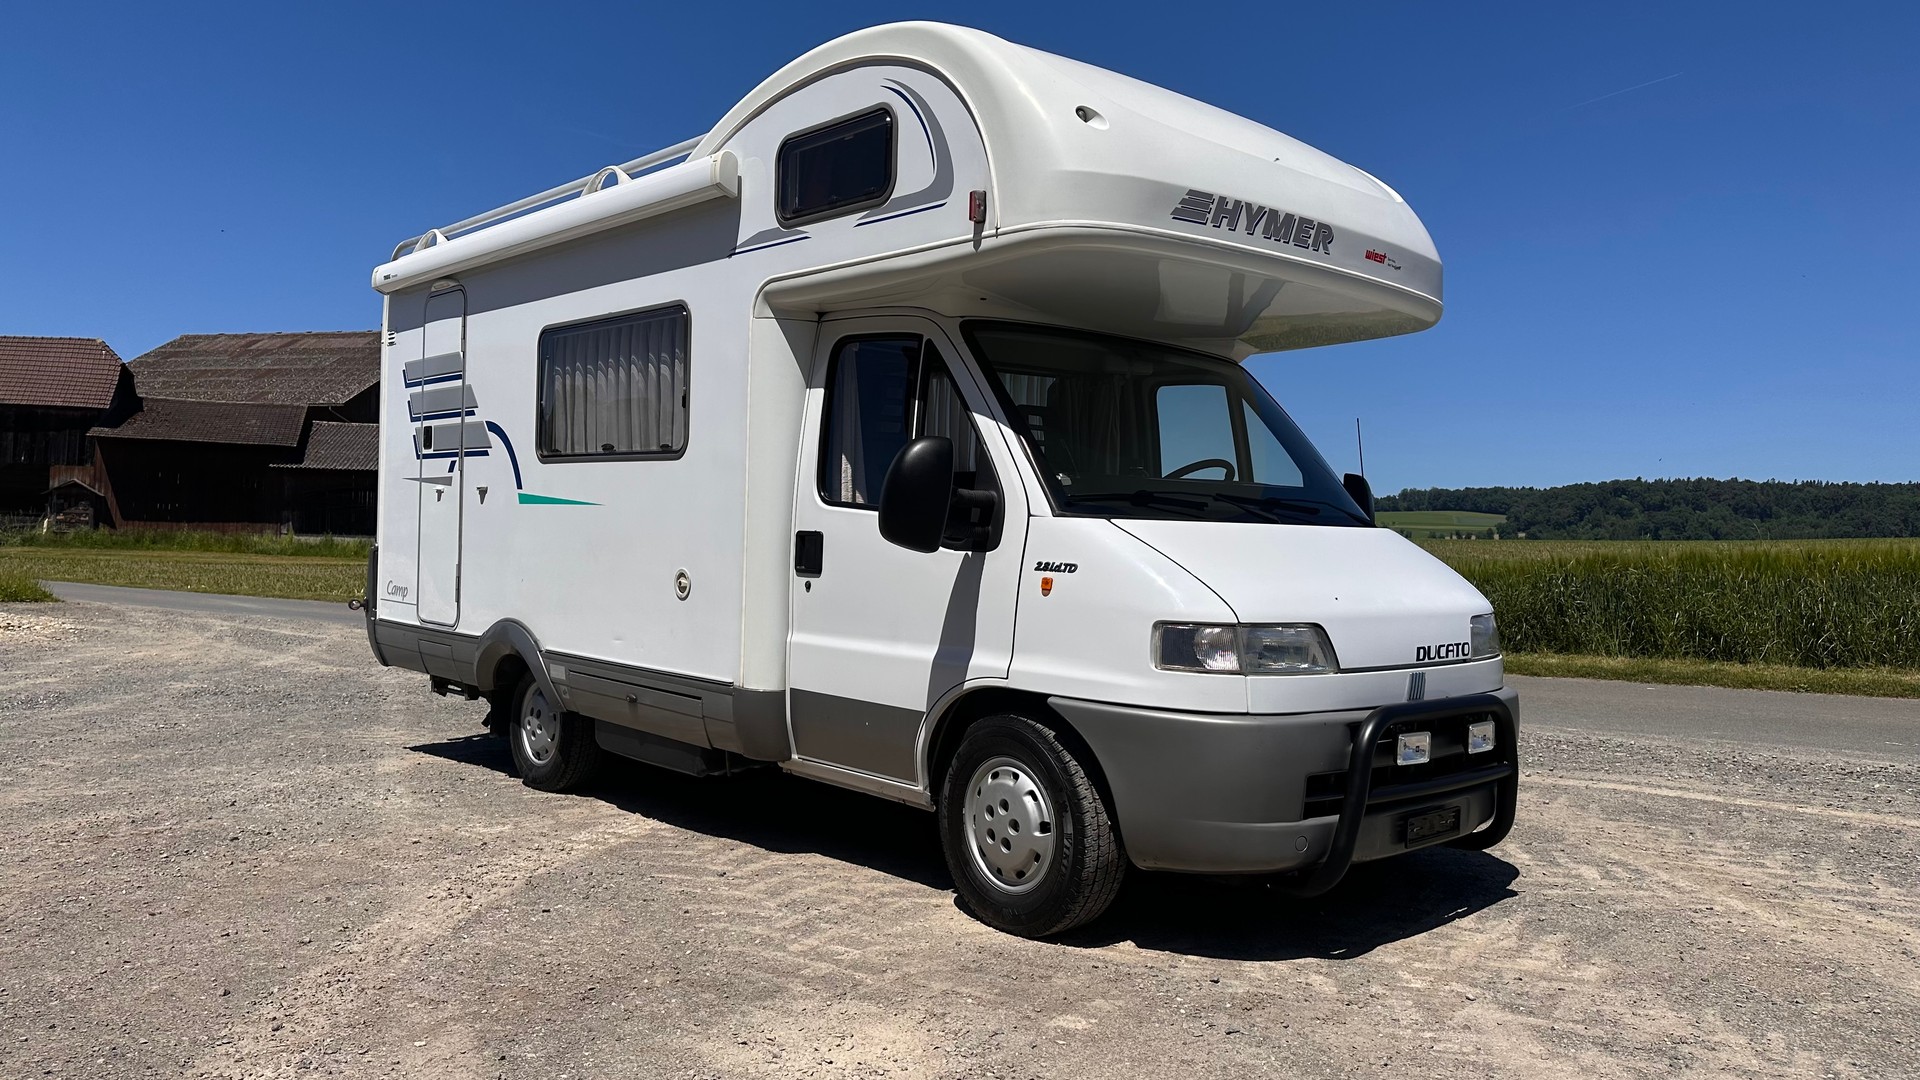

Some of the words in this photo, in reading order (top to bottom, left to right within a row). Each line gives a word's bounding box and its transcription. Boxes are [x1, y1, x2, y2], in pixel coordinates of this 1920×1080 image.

[1210, 195, 1335, 255] HYMER
[1365, 249, 1387, 265] wiest
[386, 580, 409, 601] Camp
[1416, 641, 1470, 662] DUCATO
